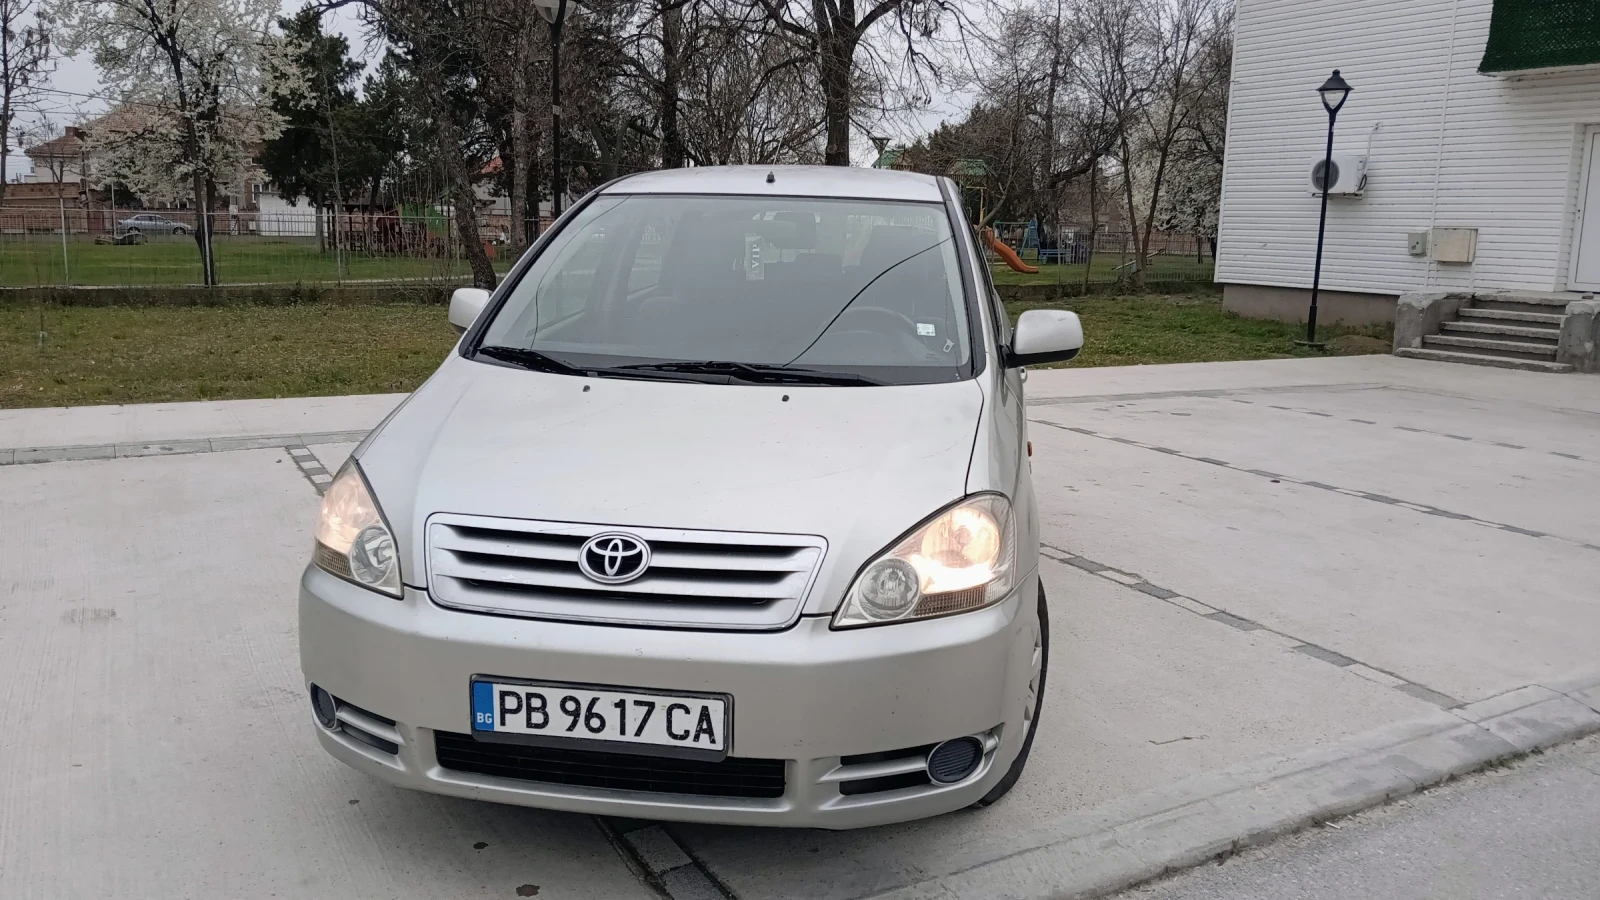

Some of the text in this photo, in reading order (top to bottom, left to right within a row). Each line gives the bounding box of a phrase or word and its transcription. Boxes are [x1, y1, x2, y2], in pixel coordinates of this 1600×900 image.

[476, 712, 493, 724] BG
[499, 690, 717, 745] PB 9617 CA
